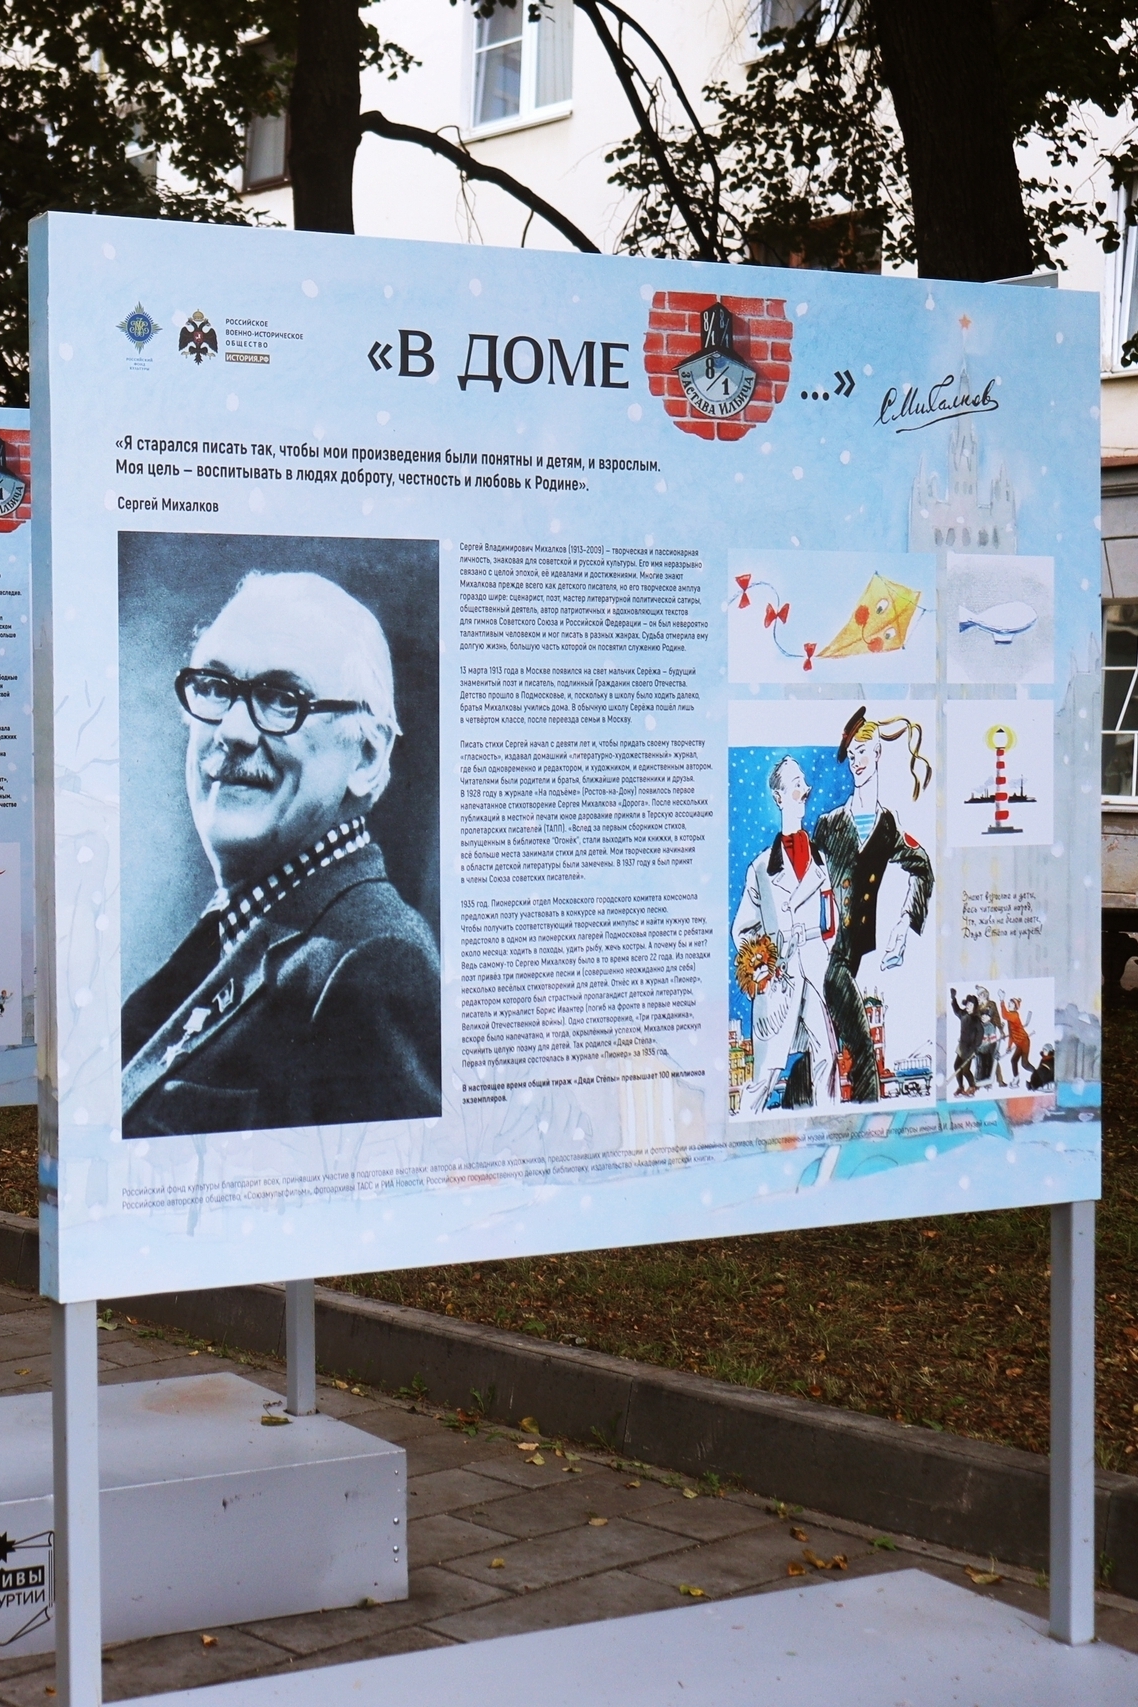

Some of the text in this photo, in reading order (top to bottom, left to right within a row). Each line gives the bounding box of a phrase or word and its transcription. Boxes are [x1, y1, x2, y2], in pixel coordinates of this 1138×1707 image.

[226, 318, 268, 328] РОССИЙСКОЕ
[226, 329, 304, 340] ВОЕННО-ИСТОРИЧЕСКОЕ
[225, 340, 268, 349] ОБЩЕСТВО
[226, 354, 270, 364] ИСТОРИЯ.РФ
[369, 330, 630, 390] «В ДОМЕ
[706, 358, 730, 395] 8/1
[682, 371, 754, 415] ЗАСТАВА ИЛЬИЧА
[116, 435, 662, 472] «Я старался писать так, чтобы мои произведения были понятны и детям, и взрослым.
[116, 459, 144, 475] Моя
[148, 464, 180, 477] цель
[197, 466, 282, 480] воспитывать
[286, 469, 293, 480] в
[296, 470, 338, 484] людях
[341, 468, 395, 487] доброту,
[398, 473, 461, 487] честность
[465, 476, 472, 487] и
[475, 474, 521, 489] любовь
[525, 478, 531, 489] к
[535, 476, 590, 492] Родине».
[118, 496, 219, 512] Сергей Михалков
[538, 557, 572, 566] советской
[579, 558, 605, 568] русской
[606, 560, 638, 568] культуры.
[639, 559, 650, 568] Его
[664, 562, 702, 570] неразрывно
[462, 1084, 467, 1092] В
[468, 1083, 505, 1092] настоящее
[506, 1082, 527, 1090] время
[528, 1079, 551, 1088] общий
[622, 1073, 658, 1082] превышает
[659, 1071, 670, 1079] 100
[671, 1070, 706, 1078] миллионов
[463, 1095, 508, 1105] экземпляров.
[122, 1200, 165, 1210] Российское
[166, 1196, 204, 1207] авторское
[313, 1184, 356, 1195] фотоархивы
[357, 1181, 373, 1190] ТАСС
[381, 1179, 395, 1188] РИА
